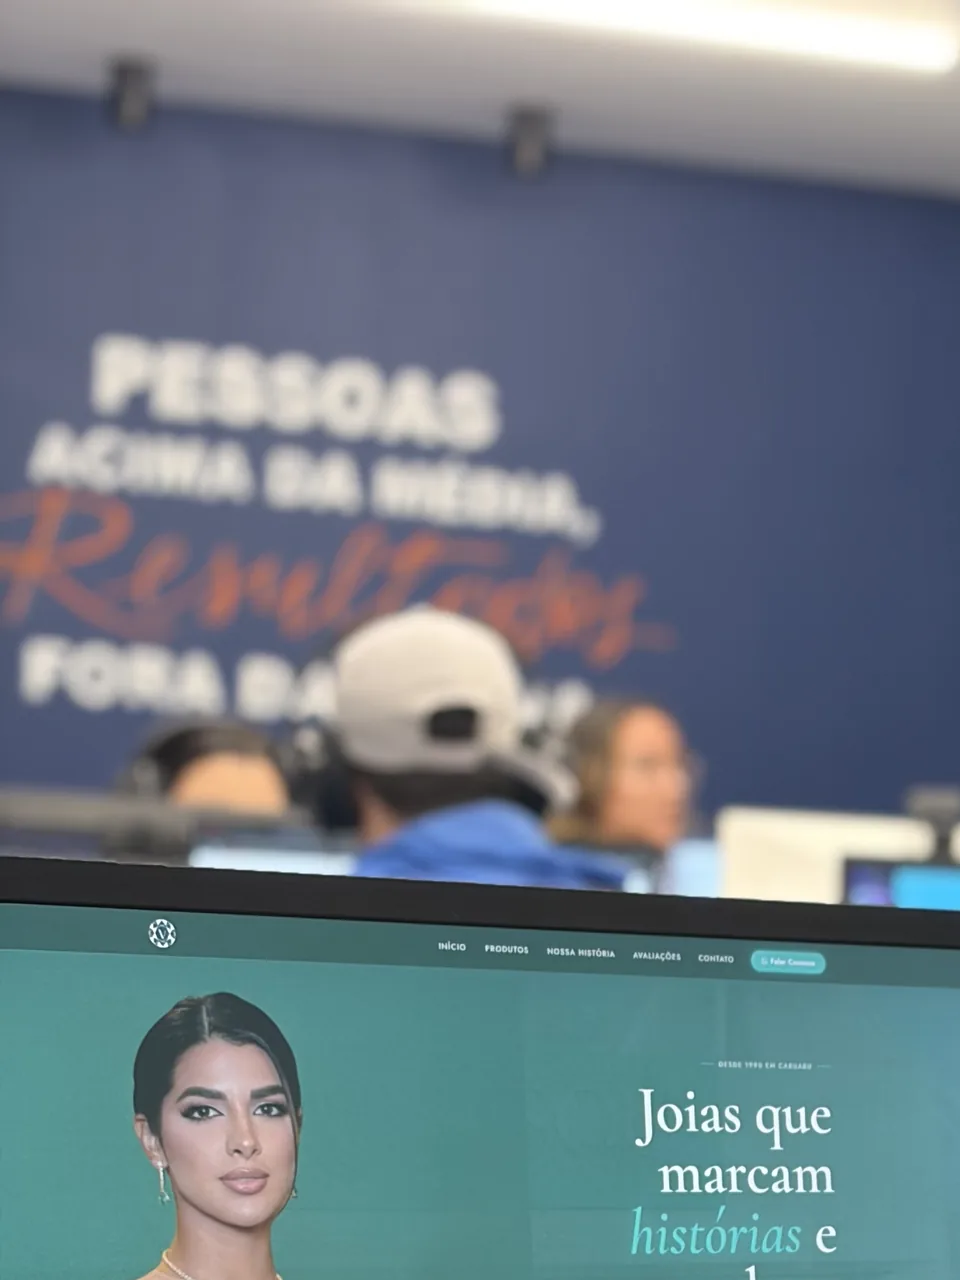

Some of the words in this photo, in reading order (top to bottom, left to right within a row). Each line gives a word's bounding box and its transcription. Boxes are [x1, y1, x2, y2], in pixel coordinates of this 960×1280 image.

[92, 333, 500, 453] PESSOAS
[26, 421, 254, 500] ACIMA
[263, 444, 362, 515] DA
[20, 635, 226, 714] FORA
[438, 941, 466, 951] INÍCIO
[484, 944, 529, 954] PRODUTOS
[546, 947, 576, 956] NOSSA
[578, 948, 615, 958] HISTÓRIA
[633, 951, 681, 962] AVALIAÇÕES
[698, 954, 734, 963] CONTATO
[635, 1088, 741, 1147] Joias
[755, 1103, 832, 1150] que
[658, 1163, 835, 1194] marcam
[630, 1205, 801, 1255] histórias
[815, 1224, 837, 1253] e
